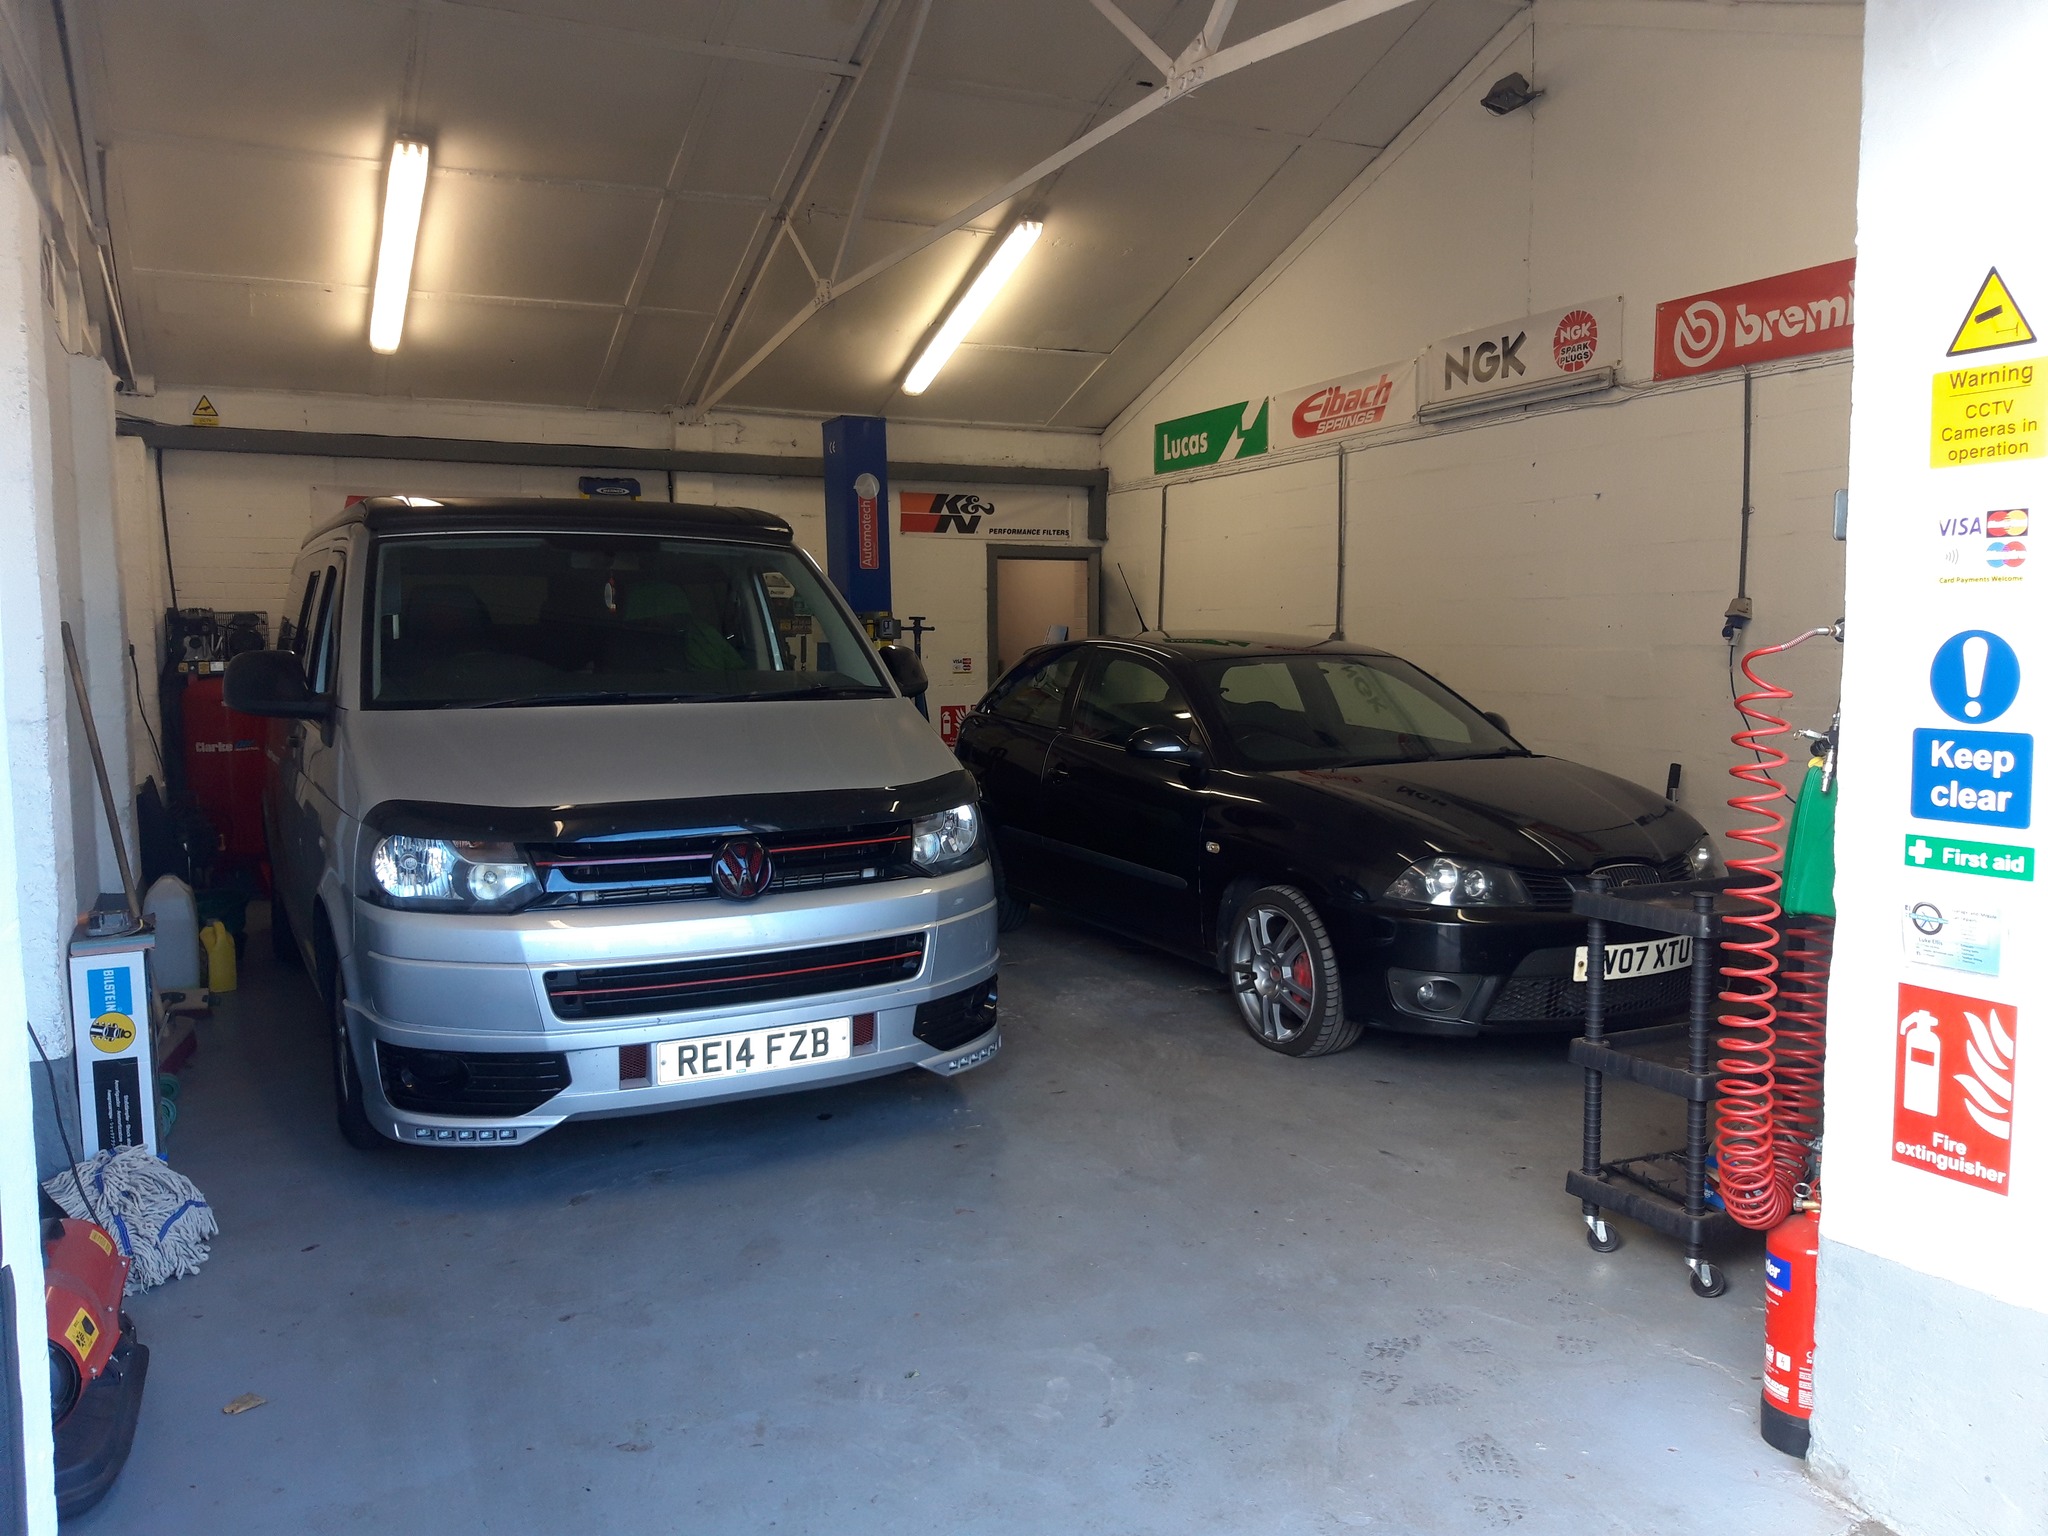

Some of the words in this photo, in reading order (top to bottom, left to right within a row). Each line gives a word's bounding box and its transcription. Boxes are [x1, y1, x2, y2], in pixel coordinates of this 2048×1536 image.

[1734, 280, 1854, 348] brem
[1560, 321, 1592, 343] NGK
[1444, 331, 1528, 391] NGK
[1559, 351, 1590, 364] PLUGS
[1560, 342, 1589, 356] SPARK
[1949, 364, 2034, 390] Warning
[1292, 374, 1394, 430] Eibach
[1965, 399, 2014, 419] CCTV
[1315, 410, 1376, 435] SPRINGS
[1941, 422, 2016, 442] Cameras
[2022, 418, 2037, 433] in
[1163, 431, 1209, 461] Lucas
[1948, 440, 2029, 464] operation
[861, 500, 872, 567] Automotech
[988, 528, 1041, 536] PERFORMANCE
[1939, 517, 1982, 537] VISA
[1956, 576, 1990, 584] Payments
[1991, 575, 2024, 583] Welcome
[1930, 739, 2015, 779] Keep
[1930, 780, 2013, 813] clear
[1942, 847, 1989, 869] First
[1992, 853, 2025, 874] aid
[1603, 944, 1649, 975] V07
[1652, 937, 1691, 969] XTU
[103, 969, 117, 1012] BILSTEIN
[678, 1037, 755, 1077] RE14
[766, 1026, 830, 1065] FZB
[1932, 1131, 1967, 1156] Fire
[1895, 1141, 2007, 1184] extinguisher
